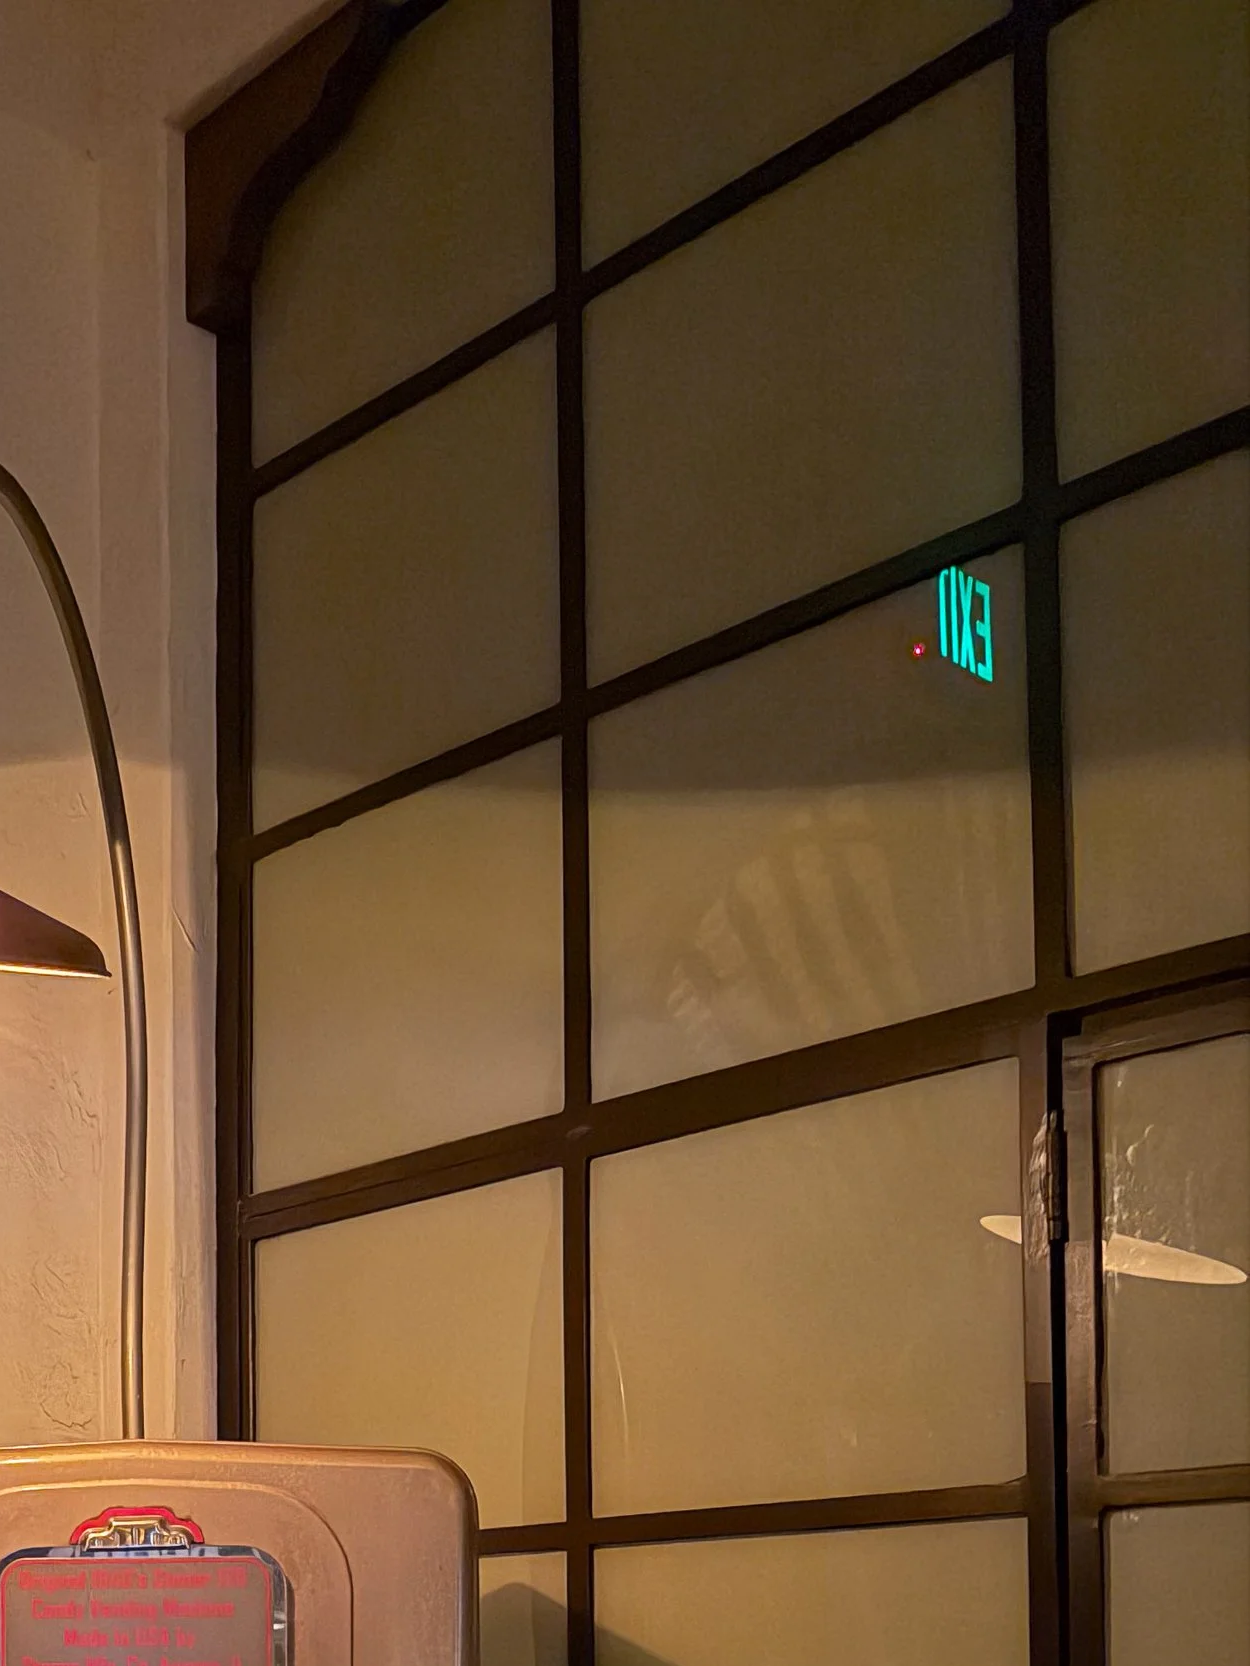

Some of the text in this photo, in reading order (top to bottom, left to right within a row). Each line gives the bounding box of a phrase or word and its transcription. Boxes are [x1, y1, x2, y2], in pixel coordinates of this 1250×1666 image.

[64, 1626, 195, 1650] Made in USA by
